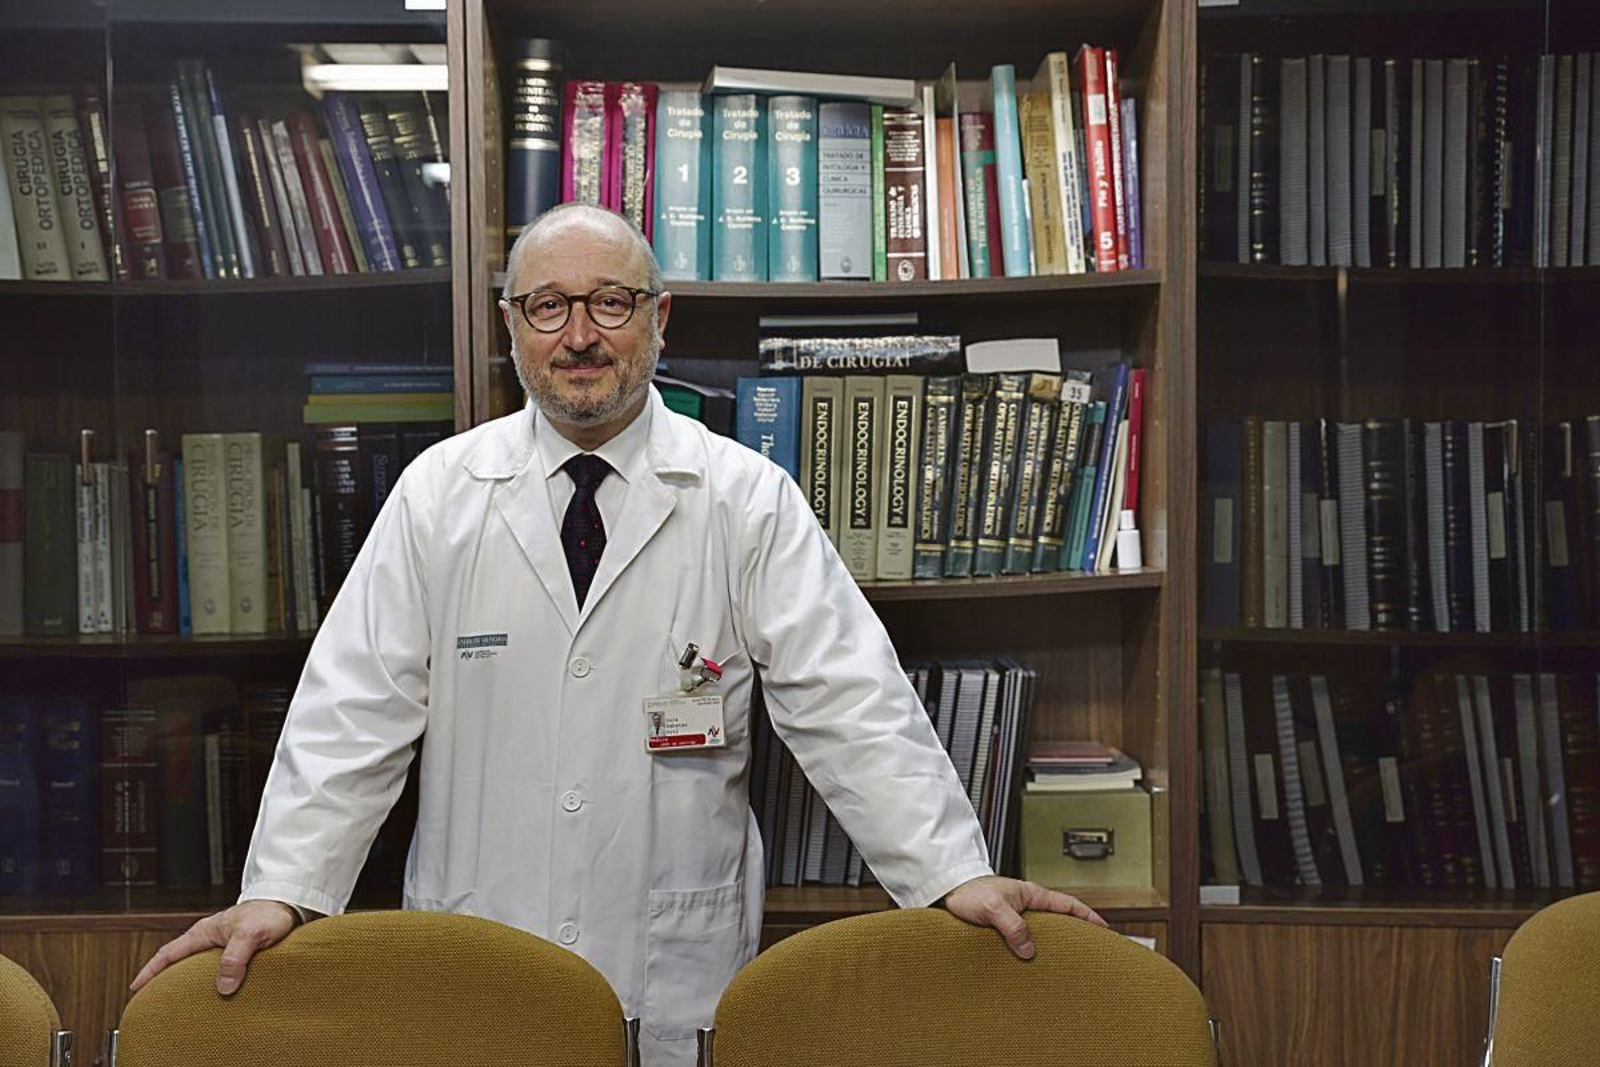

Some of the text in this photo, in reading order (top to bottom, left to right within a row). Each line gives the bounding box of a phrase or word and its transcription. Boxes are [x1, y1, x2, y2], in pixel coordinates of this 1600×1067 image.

[667, 106, 704, 117] Tratado
[722, 109, 759, 120] Tratado
[774, 110, 812, 121] Tratado
[11, 129, 33, 196] CIRUGIA
[27, 128, 54, 231] ORTOPEDICA
[51, 129, 73, 197] CIRUGIA
[65, 128, 95, 231] ORTOPEDICA
[677, 164, 689, 182] 1
[732, 166, 748, 185] 2
[786, 166, 801, 186] 3
[1099, 231, 1113, 250] 5
[800, 353, 904, 369] DE CIRUGIA
[1070, 387, 1083, 400] 35
[891, 400, 908, 515] ENDOCRINOLOGY
[1025, 402, 1041, 459] OPERATIVE
[1053, 401, 1070, 457] OPERATIVE
[191, 443, 208, 532] CIRUGIA
[228, 441, 245, 529] CIRUGIA
[813, 401, 829, 517] ENDOCRINOLOGY
[854, 401, 870, 517] ENDOCRINOLOGY
[983, 402, 1007, 535] OPERATIVE ORTHOPAEDICS
